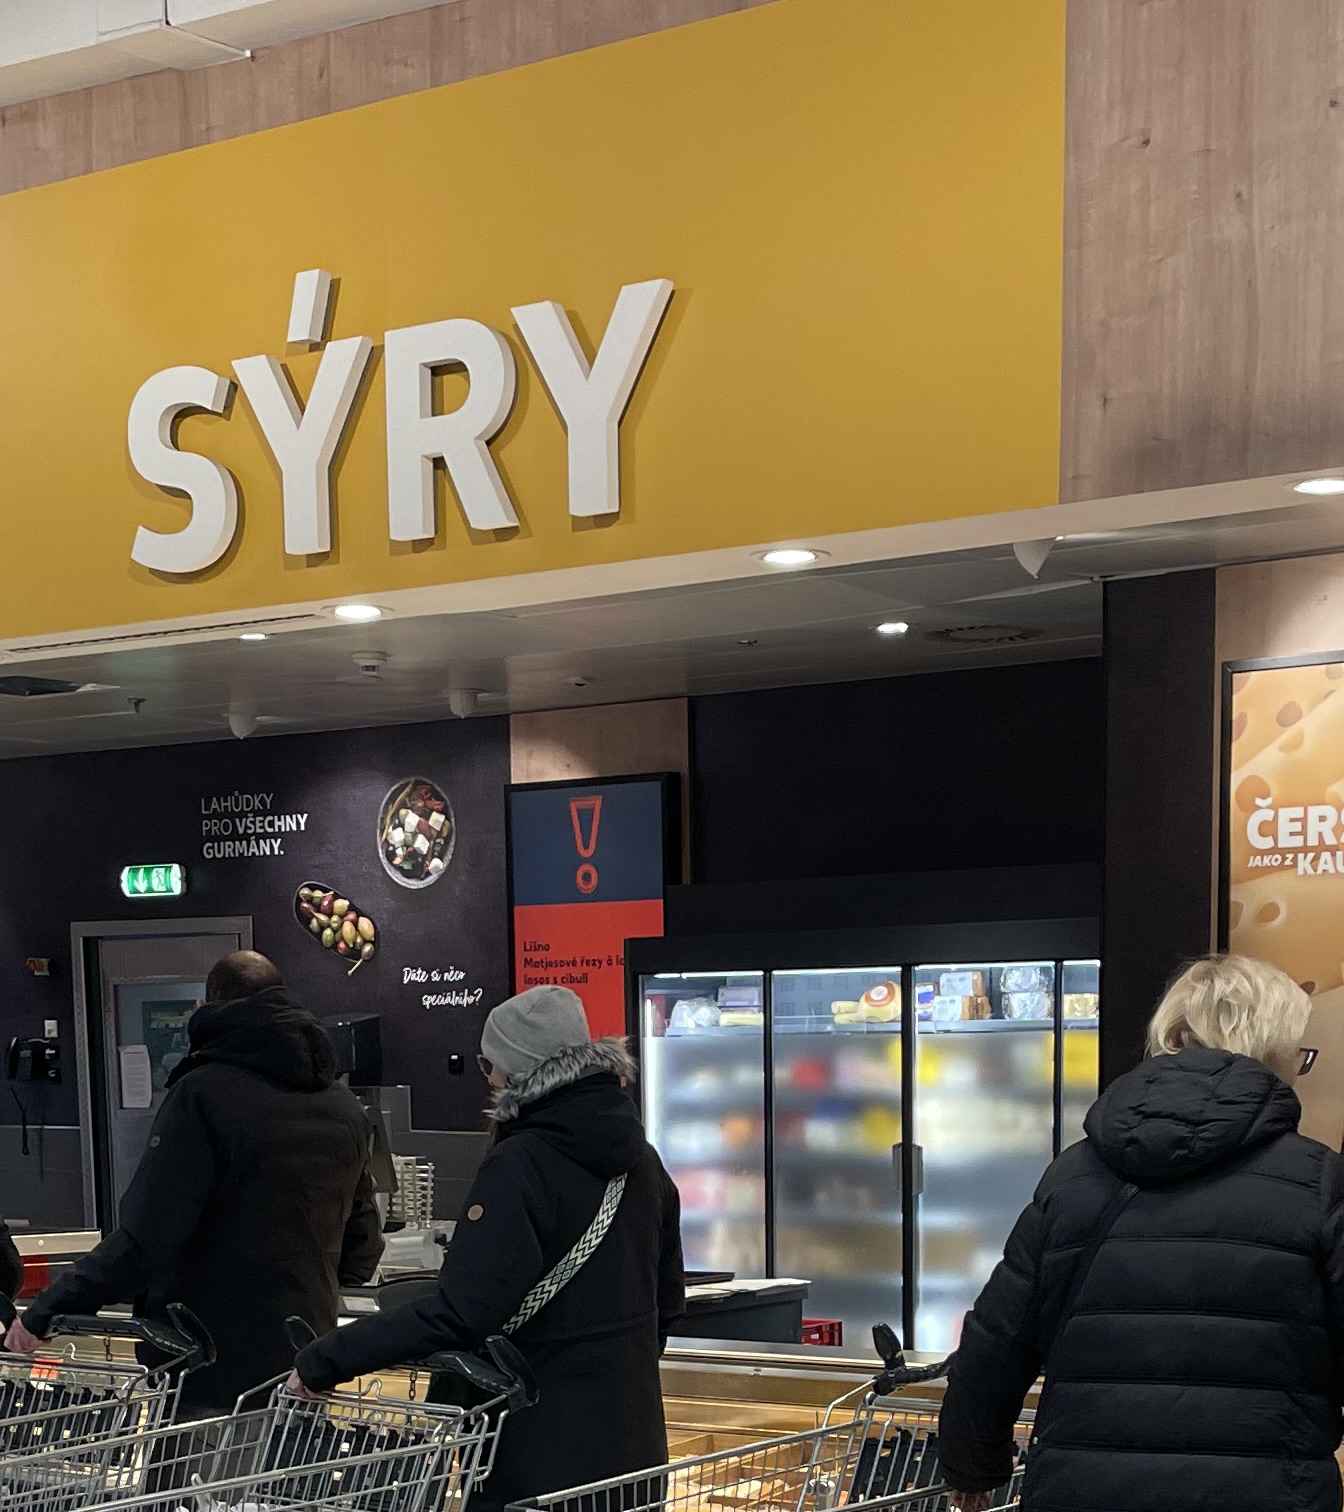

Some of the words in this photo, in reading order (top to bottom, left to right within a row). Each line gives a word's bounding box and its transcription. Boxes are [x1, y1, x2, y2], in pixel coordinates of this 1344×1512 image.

[127, 268, 674, 574] SÝRY
[201, 790, 274, 815] LAHŮDKY
[202, 819, 233, 837] PRO
[235, 813, 308, 835] VŠECHNY
[202, 836, 284, 859] GURMÁNY.
[1248, 853, 1282, 869] JAKO
[1284, 853, 1294, 866] Z
